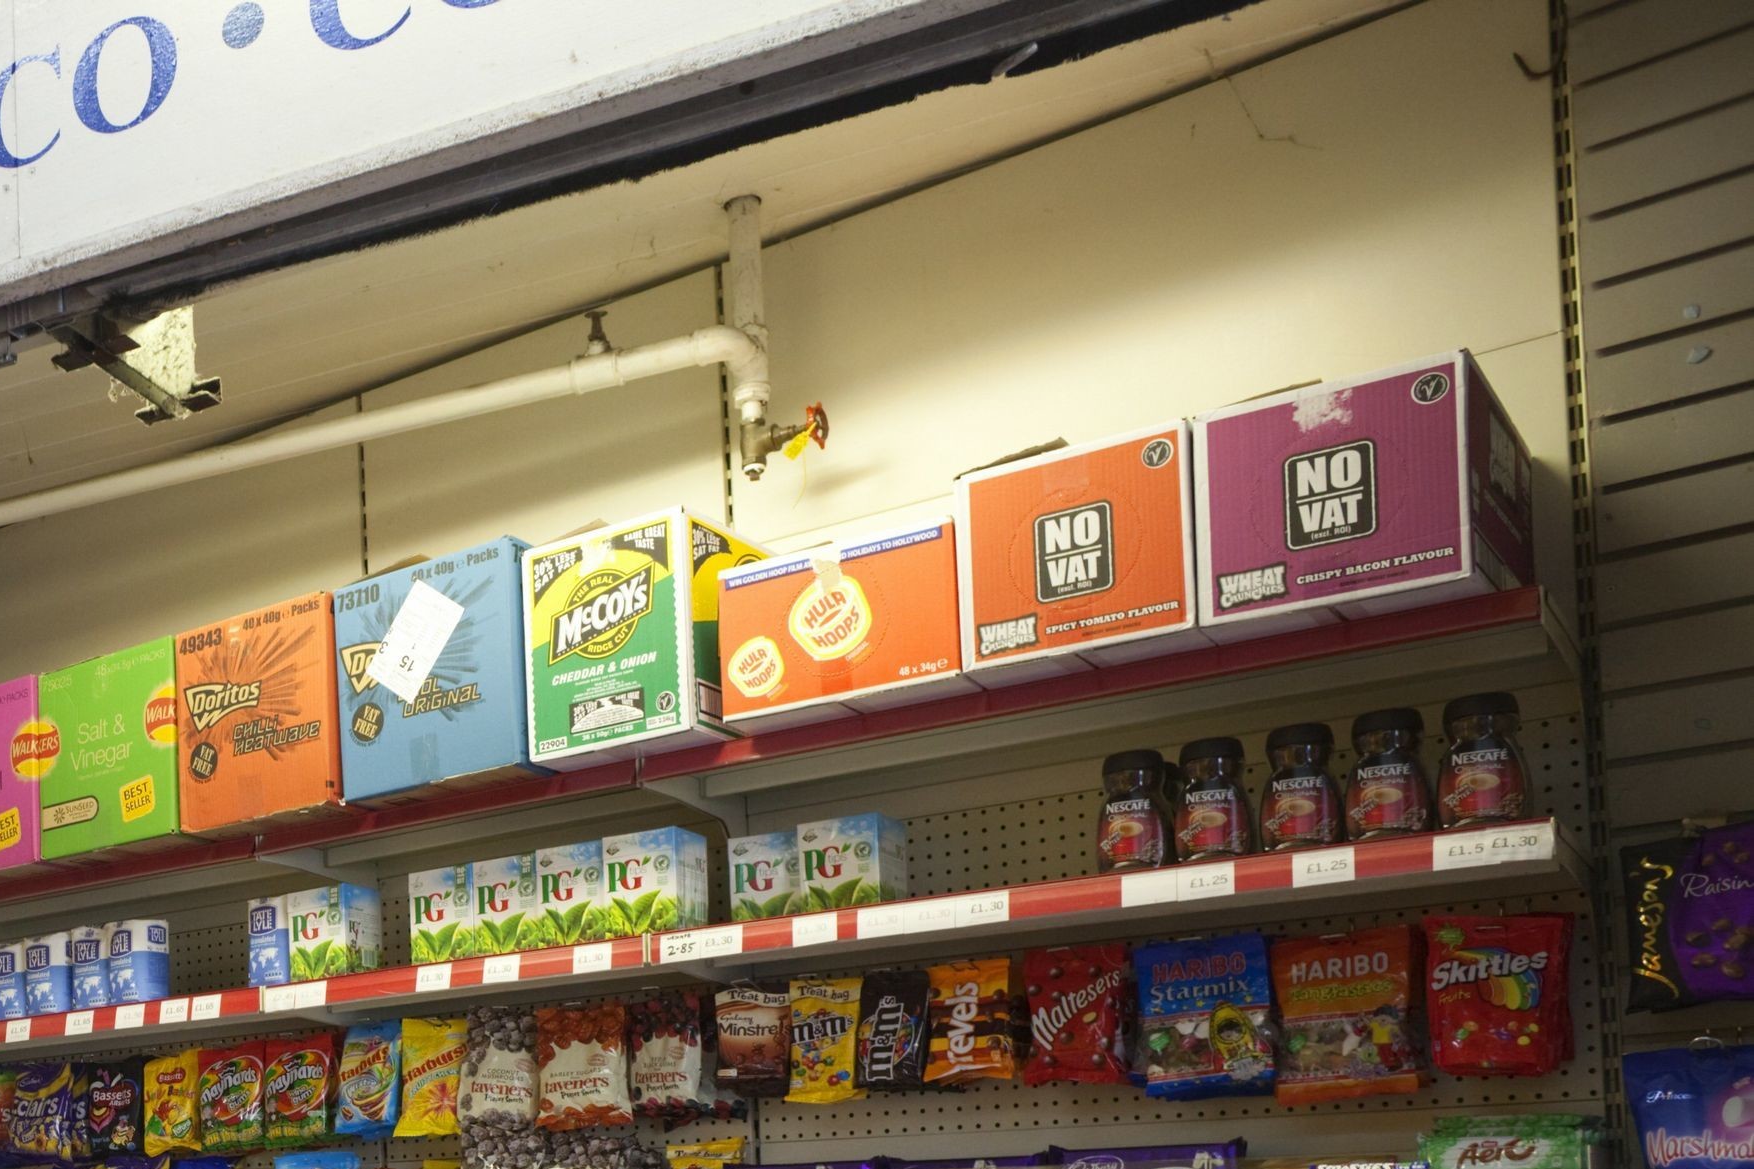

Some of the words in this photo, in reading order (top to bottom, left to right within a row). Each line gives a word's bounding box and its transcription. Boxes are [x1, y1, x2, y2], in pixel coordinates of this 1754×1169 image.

[1295, 448, 1362, 497] NO
[848, 543, 881, 558] HOLIDAYS
[891, 530, 938, 548] HOLLYWOOD
[1044, 508, 1100, 553] NO
[1046, 552, 1101, 587] VAT
[1296, 567, 1342, 585] CRISPY
[1345, 557, 1390, 576] BACON
[1394, 546, 1454, 569] FLAVOUR
[337, 584, 380, 612] 73710
[573, 586, 588, 603] THE
[590, 576, 613, 587] REAL
[804, 590, 847, 629] HULA
[1045, 620, 1076, 635] SPICY
[1078, 611, 1125, 630] TOMATO
[1128, 601, 1179, 620] FLAVOUR
[179, 628, 223, 655] 49343
[290, 598, 321, 617] Packs
[588, 641, 612, 653] RIDGE
[614, 626, 630, 643] CUT
[979, 615, 1036, 641] WHEAT
[552, 667, 604, 686] CHEDDAR
[620, 651, 657, 670] ONION
[191, 678, 263, 715] Doritos
[403, 682, 481, 718] ORIGINAL
[76, 717, 109, 745] Salt
[540, 738, 566, 751] 22904
[70, 740, 134, 773] Vinegar
[1492, 833, 1538, 851] £1.30
[1189, 873, 1229, 889] £1.25
[1306, 859, 1348, 874] £1.25
[970, 899, 1005, 915] £1.30
[293, 912, 318, 941] PG
[1153, 951, 1245, 982] HARIBO
[1290, 950, 1388, 984] HARIBO
[1430, 950, 1549, 991] Skittles
[726, 991, 759, 1002] Treat
[763, 992, 786, 1006] bag
[1149, 978, 1249, 1004] Starmix
[1030, 968, 1121, 1051] Maltesers
[471, 1080, 533, 1098] taveners
